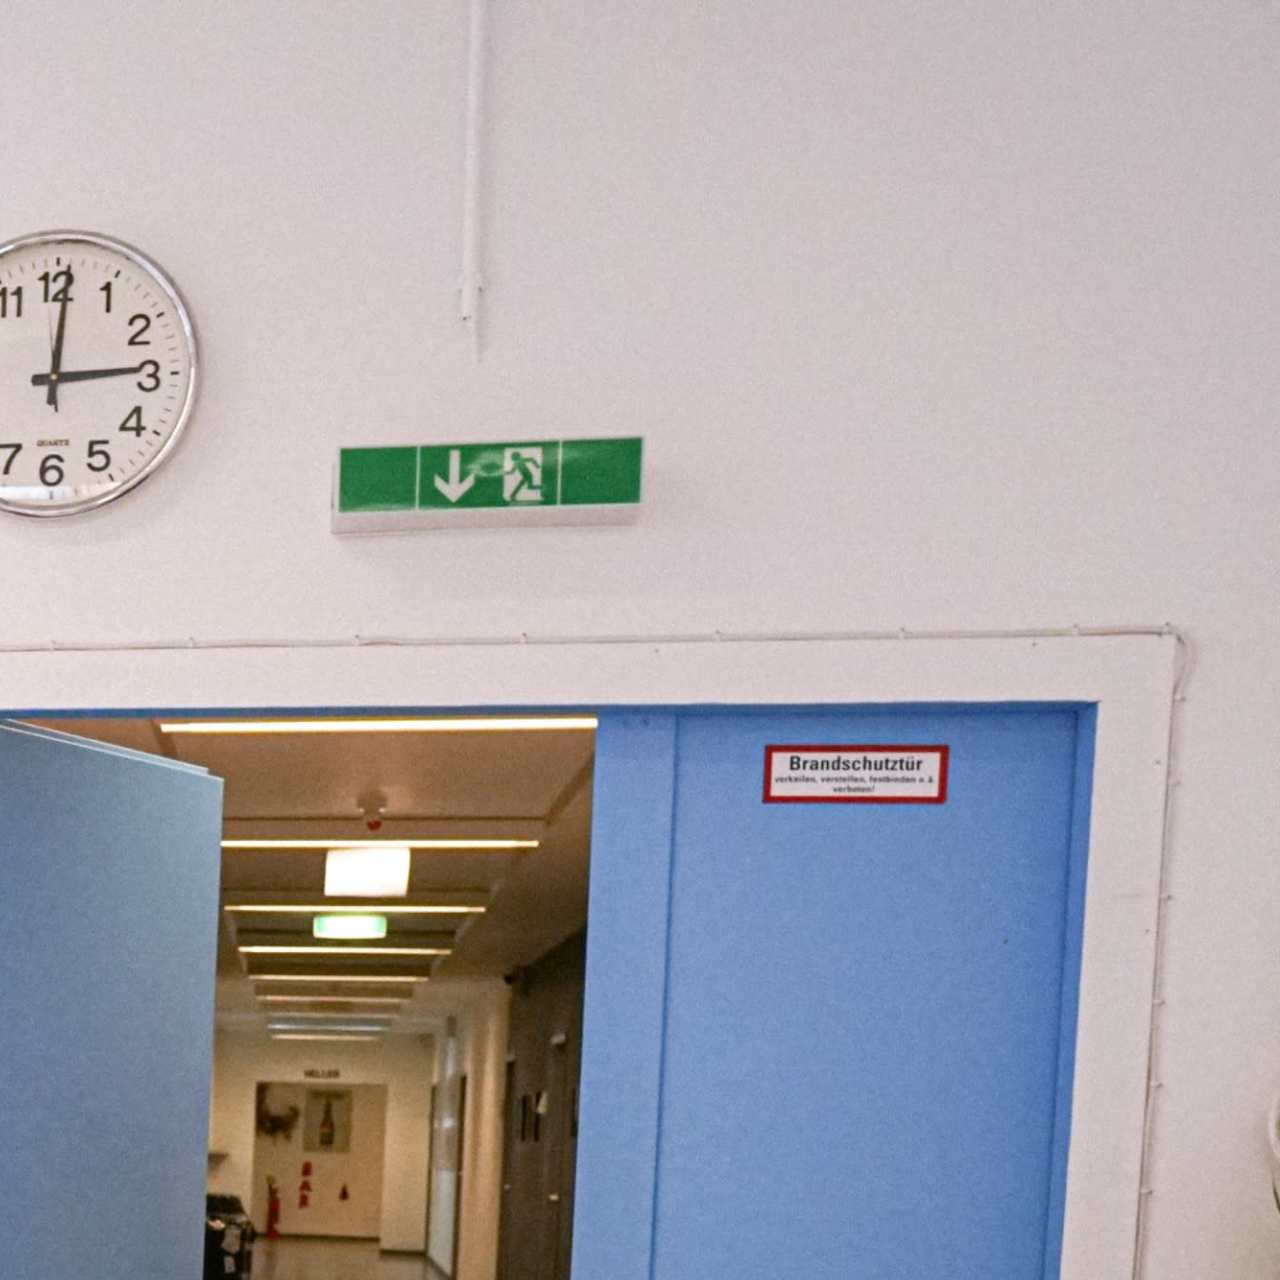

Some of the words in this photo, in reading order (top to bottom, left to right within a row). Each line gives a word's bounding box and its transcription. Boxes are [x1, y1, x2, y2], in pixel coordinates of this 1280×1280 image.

[37, 271, 74, 302] 12
[99, 281, 113, 313] 1
[127, 313, 151, 346] 2
[136, 359, 161, 392] 3
[118, 406, 146, 437] 4
[39, 454, 65, 487] 6
[86, 440, 111, 472] 5
[789, 755, 923, 772] Brandschutztür
